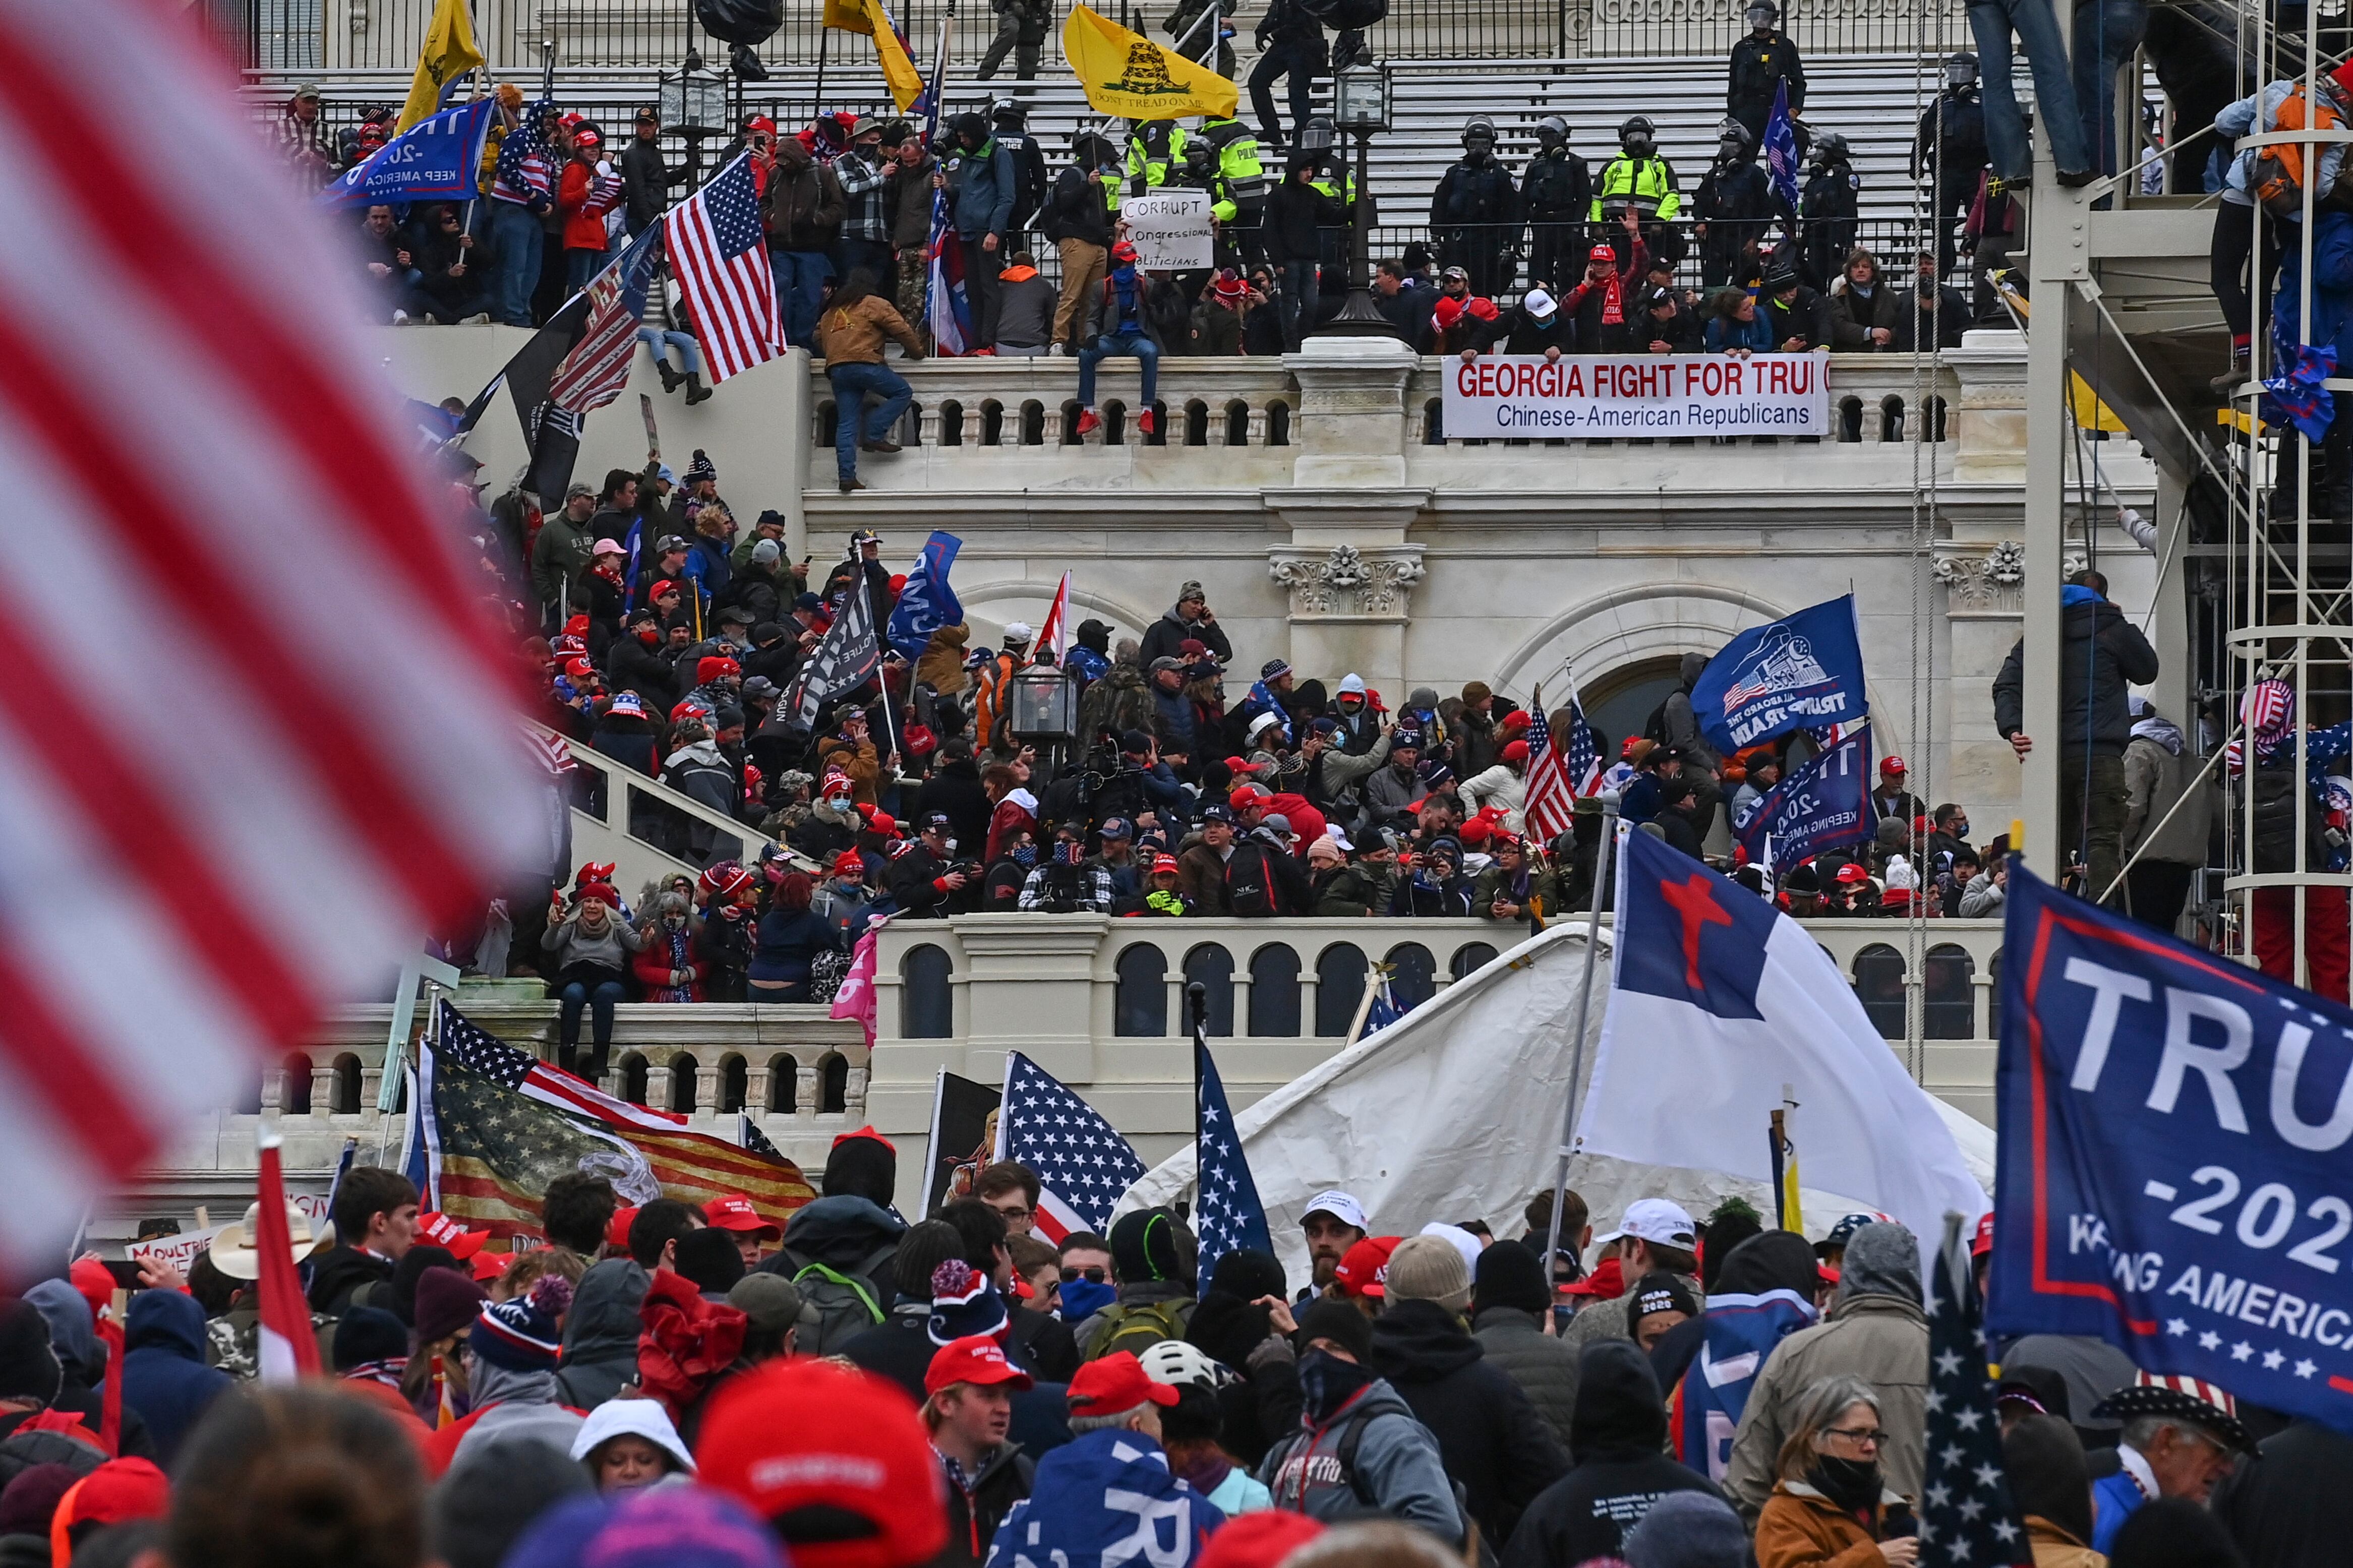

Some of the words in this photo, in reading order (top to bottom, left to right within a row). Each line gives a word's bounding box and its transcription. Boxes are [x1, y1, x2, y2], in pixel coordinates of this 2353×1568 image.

[1128, 98, 1167, 107] TREAD
[1169, 98, 1186, 106] ON
[1189, 99, 1205, 108] ME
[1237, 147, 1258, 160] POLIC
[1125, 201, 1201, 218] CORRUPT
[1457, 363, 1585, 397] GEORGIA
[1594, 364, 1676, 397] FIGHT
[1685, 362, 1742, 396] FOR
[1751, 361, 1814, 395] TRU
[1497, 404, 1680, 427] Chinese-American
[1687, 402, 1809, 430] Republicans
[1205, 806, 1220, 814] USA
[2063, 956, 2353, 1153] TRU
[1640, 1290, 1672, 1302] TRUMP
[1642, 1300, 1672, 1314] 2020
[2166, 1264, 2353, 1351] AMERIC
